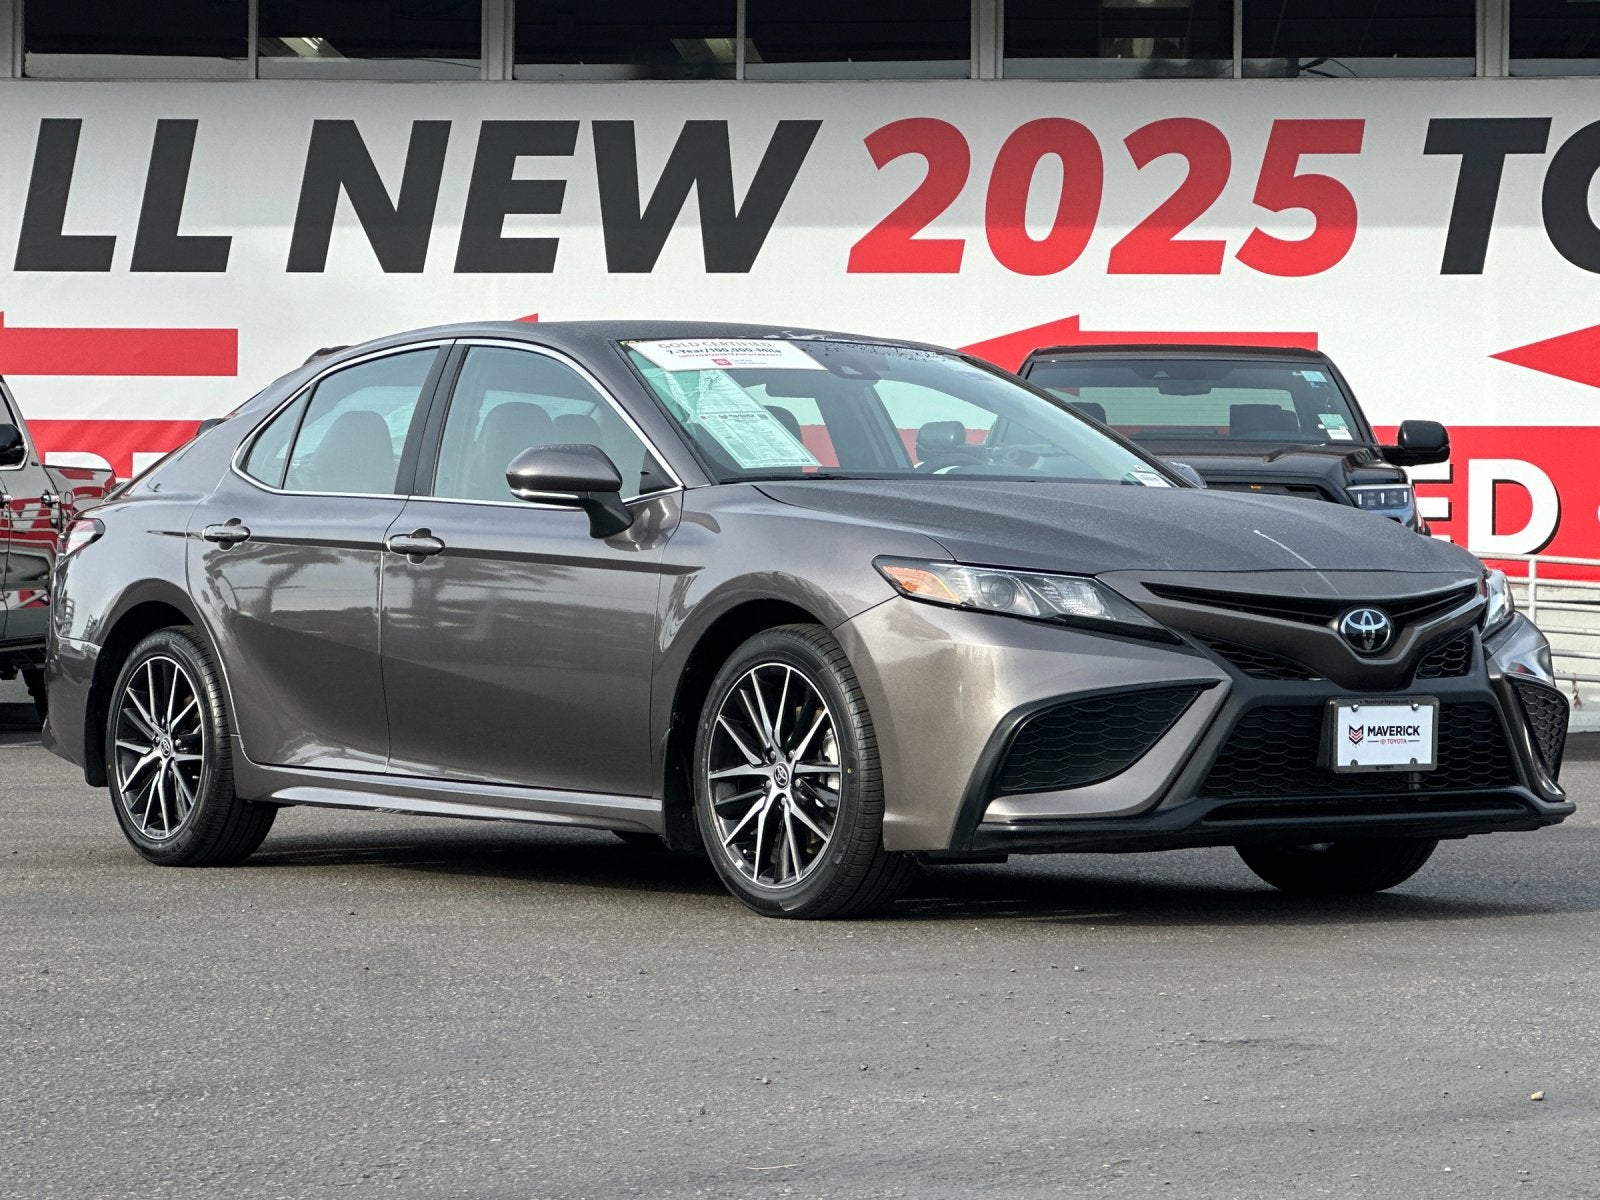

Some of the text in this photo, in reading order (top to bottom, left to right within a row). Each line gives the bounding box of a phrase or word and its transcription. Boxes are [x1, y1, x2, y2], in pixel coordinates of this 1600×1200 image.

[14, 118, 232, 272] LL
[286, 120, 823, 273] NEW
[847, 118, 1365, 277] 2025
[657, 341, 700, 349] GOLD
[1367, 725, 1420, 736] MAVERICK
